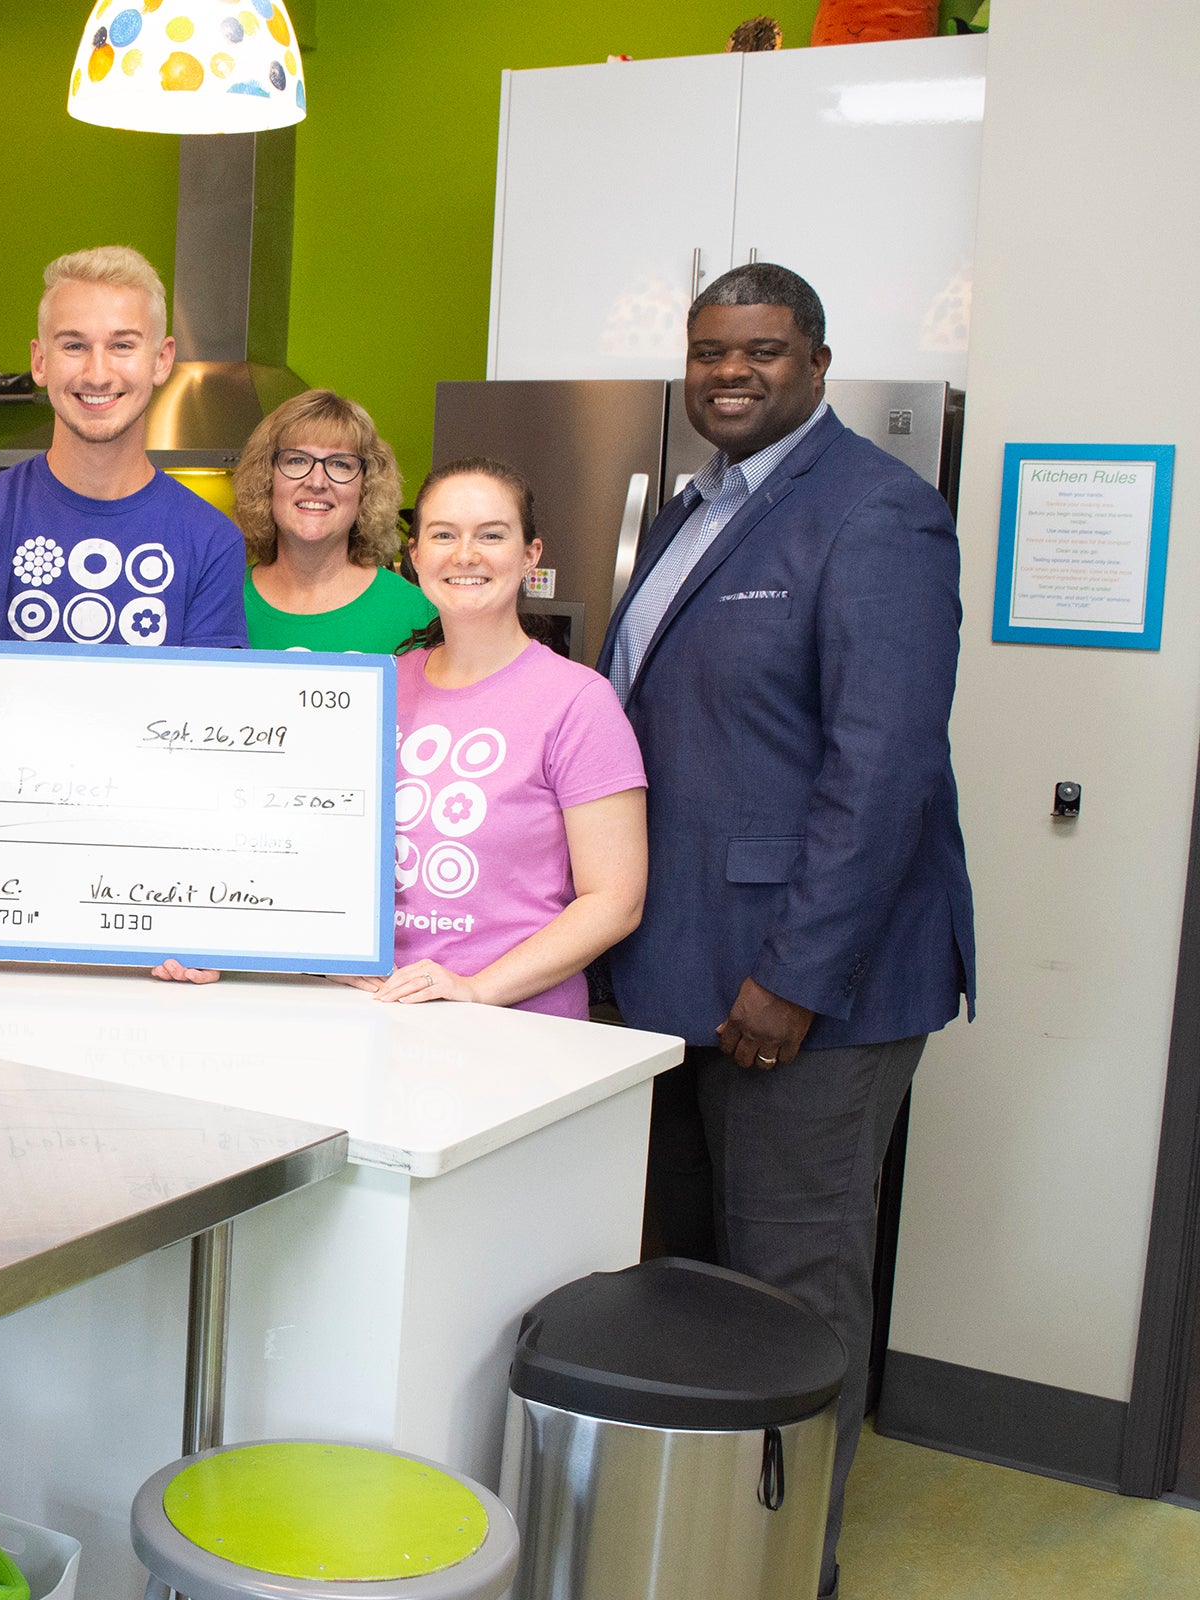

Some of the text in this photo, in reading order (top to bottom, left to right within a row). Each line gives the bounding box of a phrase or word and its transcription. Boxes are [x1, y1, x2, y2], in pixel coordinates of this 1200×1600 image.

[1031, 469, 1137, 484] Kitchen Rules
[298, 690, 351, 709] 1030
[142, 720, 194, 753] Sept.
[239, 725, 288, 747] 2019
[17, 765, 119, 802] Project
[234, 832, 293, 849] Dollars
[90, 875, 274, 906] Va. Credit Union
[100, 913, 153, 931] 1030
[394, 909, 475, 935] project
